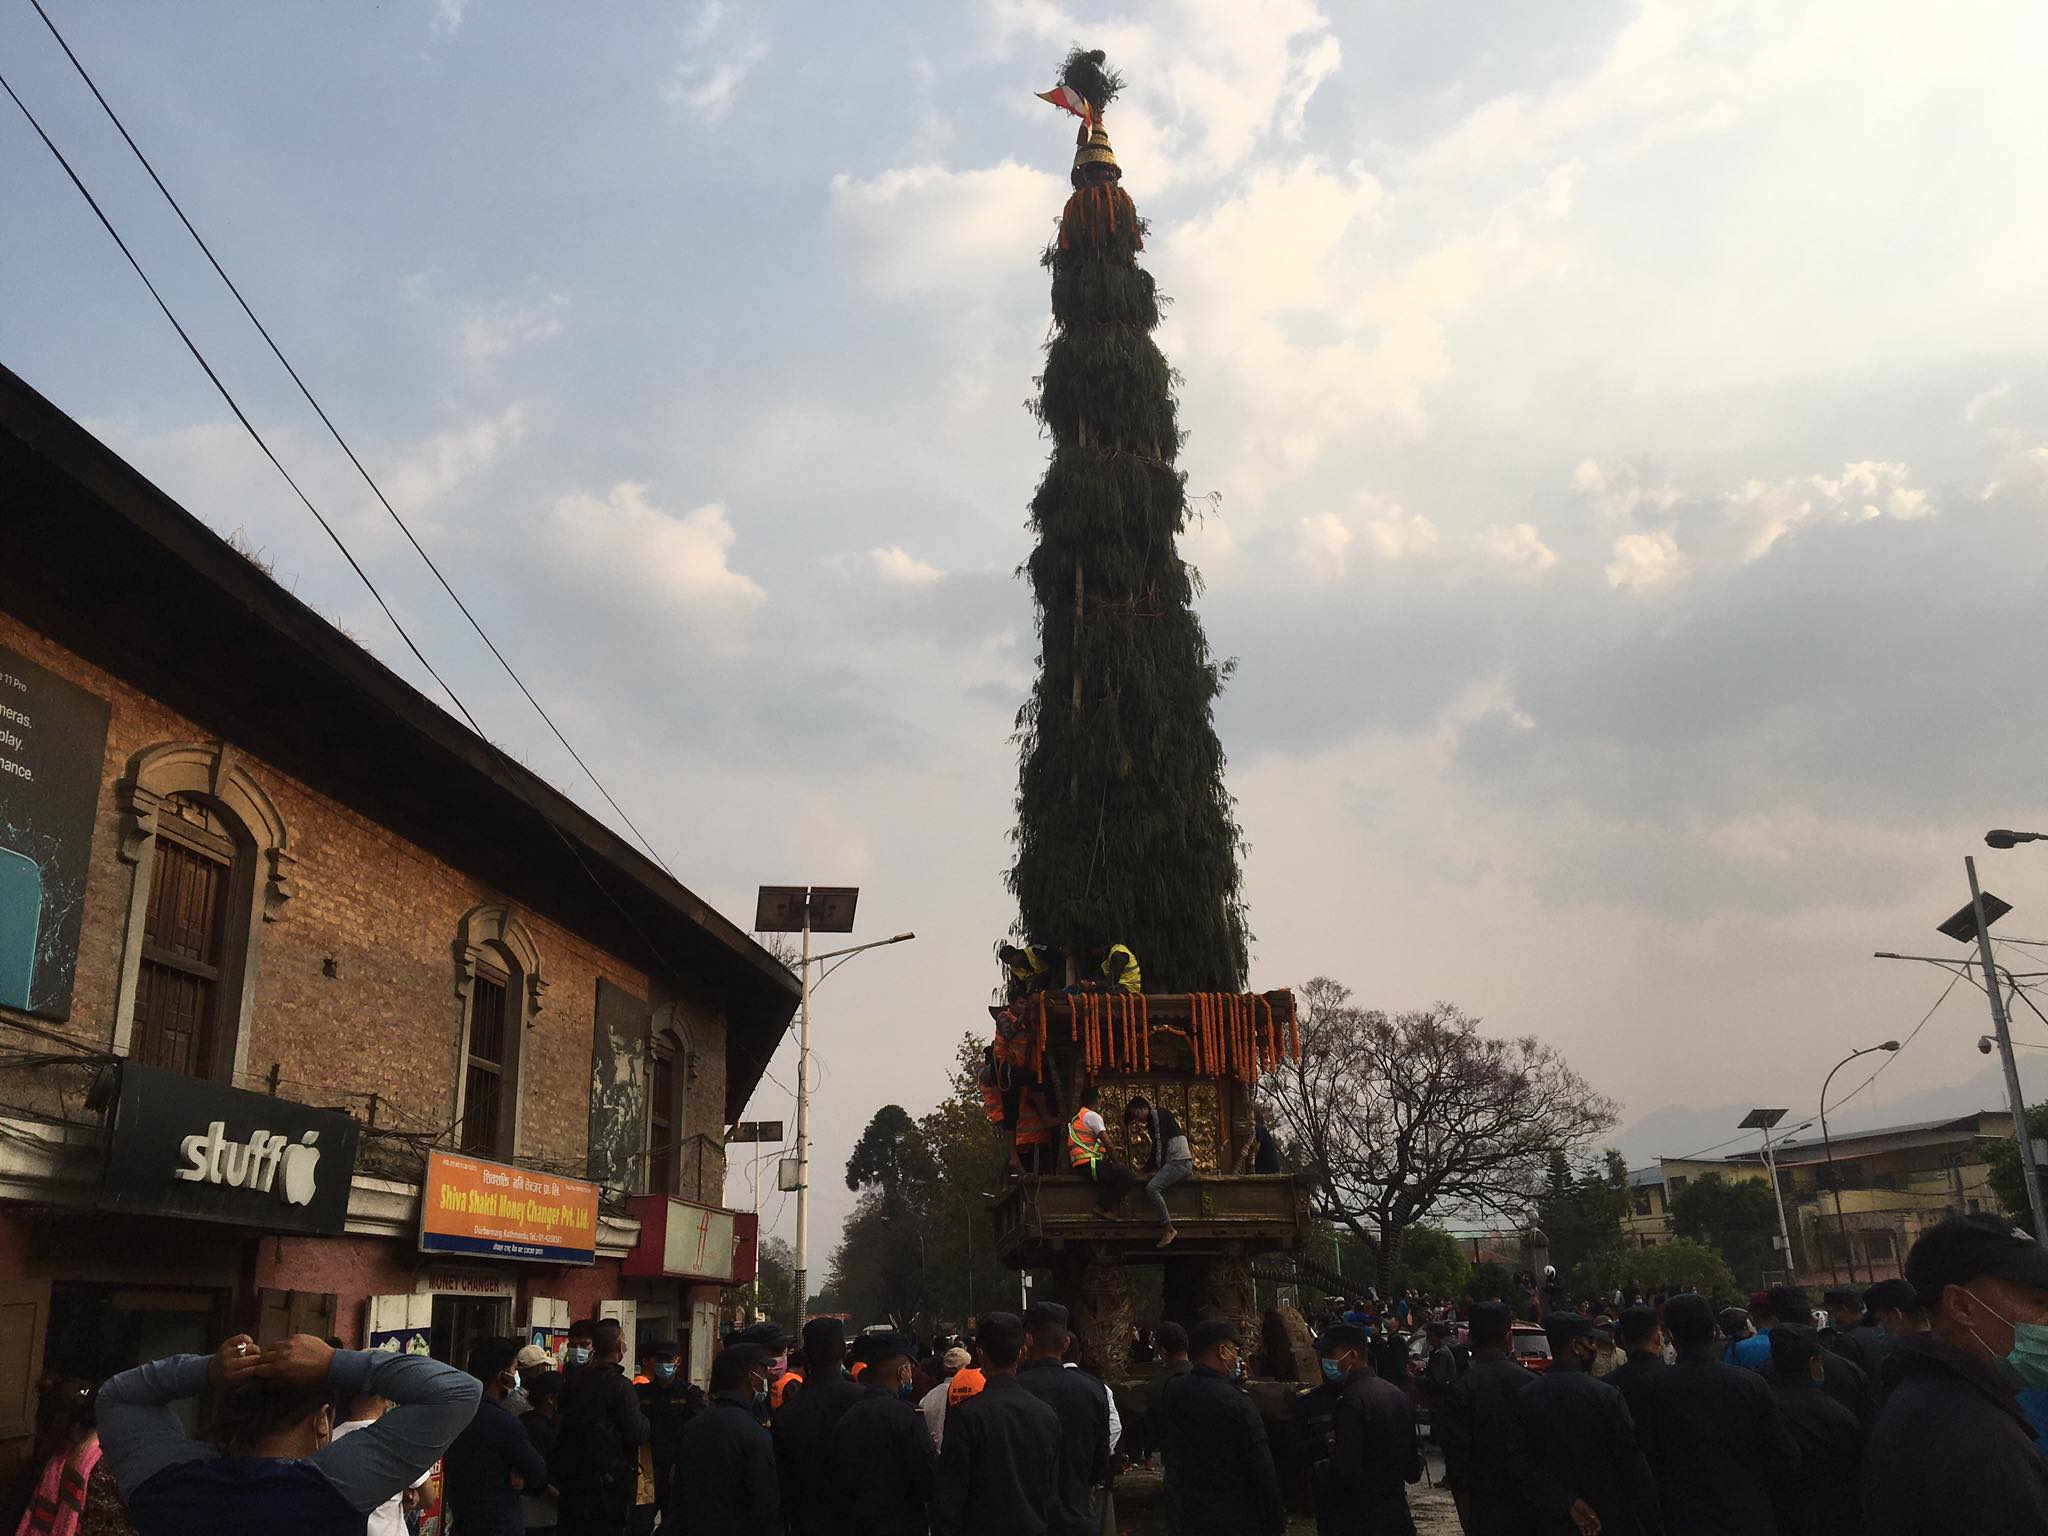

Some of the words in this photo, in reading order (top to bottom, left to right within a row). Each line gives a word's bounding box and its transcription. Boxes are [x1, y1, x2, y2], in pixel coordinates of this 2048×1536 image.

[4, 673, 13, 685] 11
[13, 678, 27, 692] Pro
[175, 1121, 288, 1193] stuff
[440, 1184, 467, 1212] Shiva
[469, 1188, 498, 1216] Shakti
[498, 1194, 526, 1228] Money
[527, 1200, 560, 1231] Changer
[561, 1205, 575, 1229] Pvt.
[576, 1208, 591, 1230] Ltd.
[429, 1274, 459, 1290] MONEY
[461, 1275, 500, 1292] CHANGER
